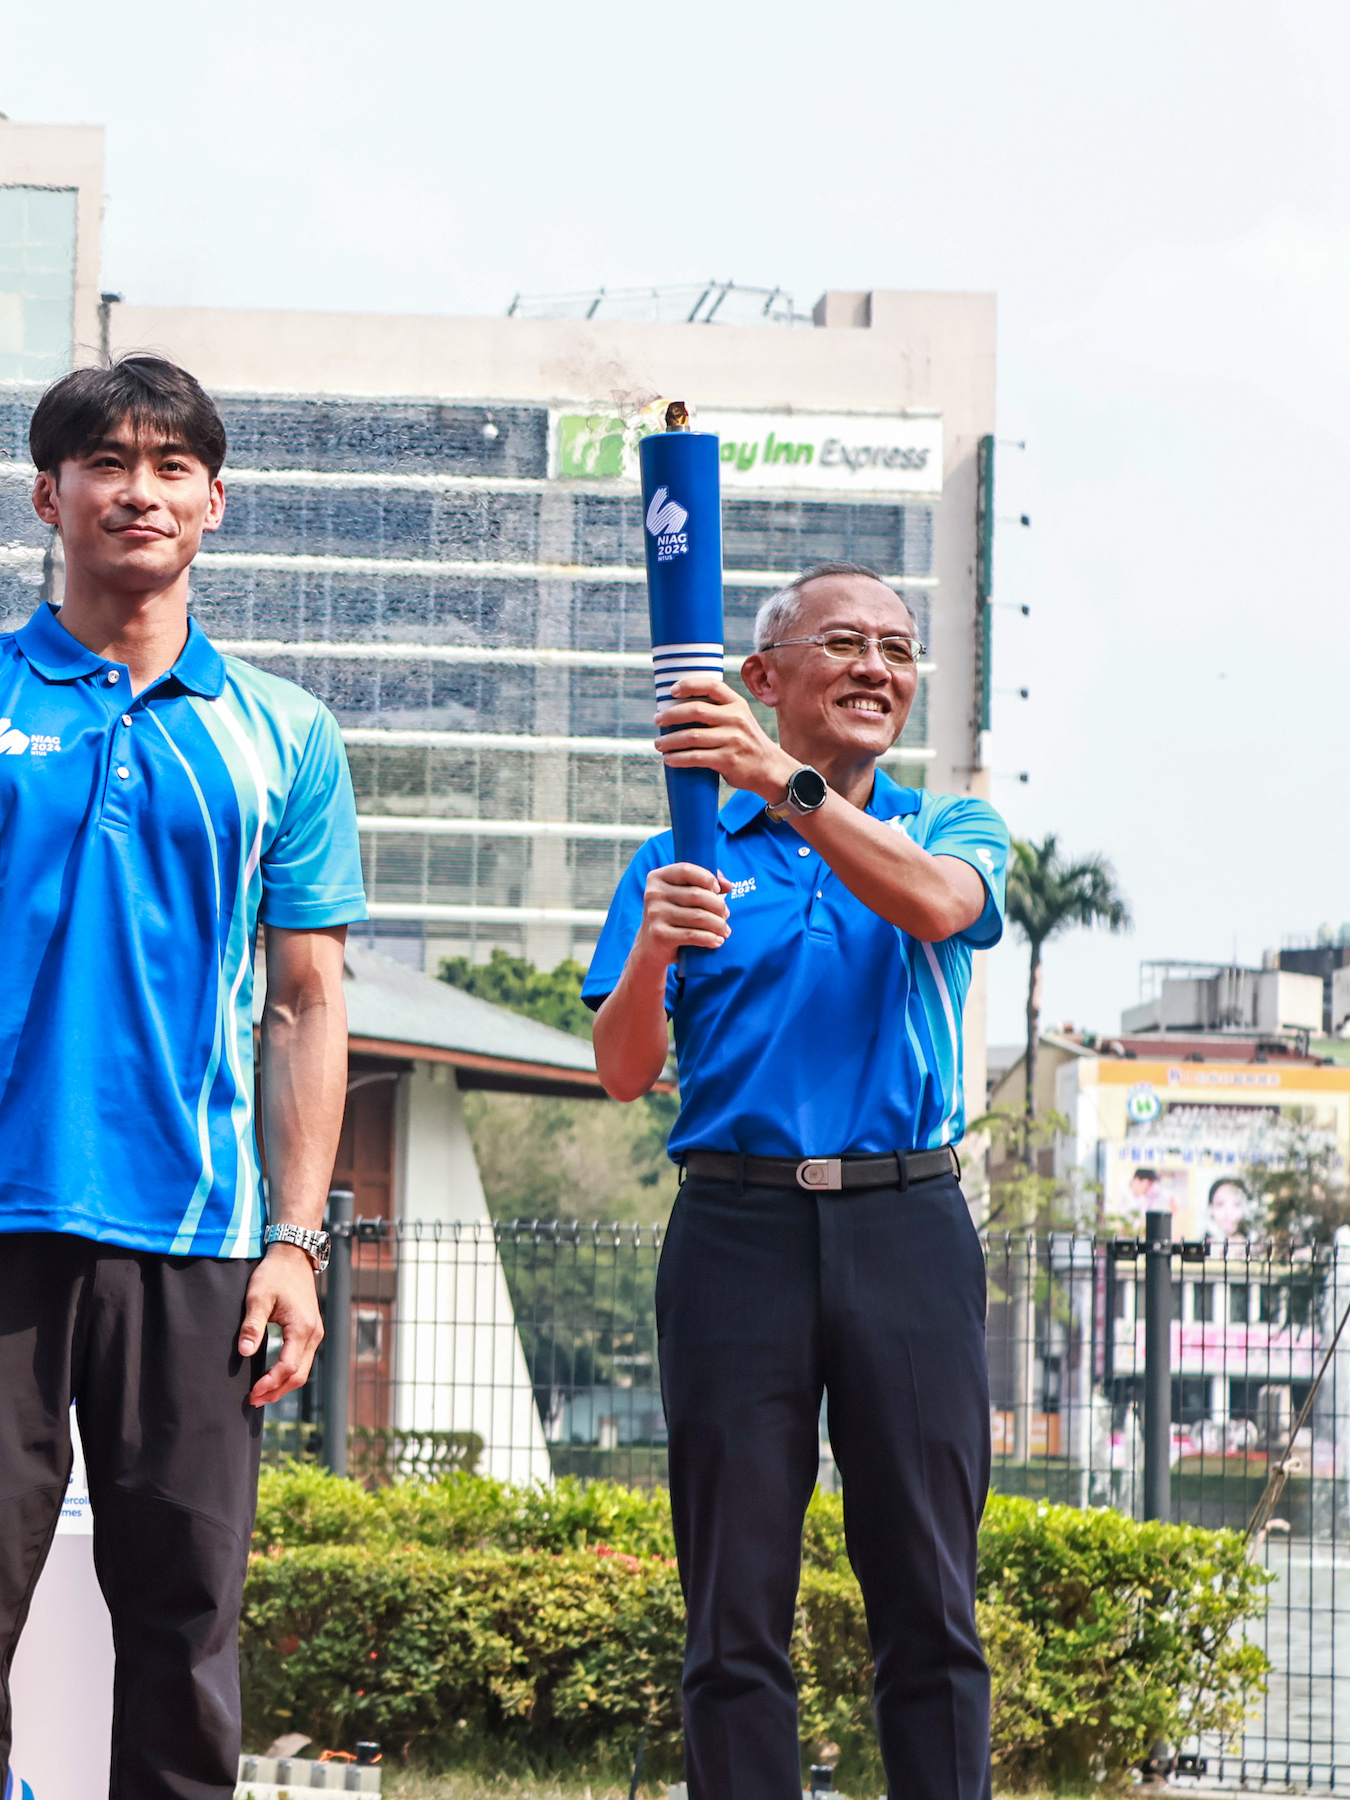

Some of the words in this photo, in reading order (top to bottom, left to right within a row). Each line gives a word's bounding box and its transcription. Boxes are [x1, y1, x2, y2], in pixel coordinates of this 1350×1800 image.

[764, 431, 814, 464] Inn
[819, 438, 931, 472] Express
[657, 533, 687, 546] NIAG
[658, 544, 687, 555] 2024
[30, 734, 61, 744] NIAG
[31, 742, 62, 752] 2024
[731, 877, 756, 889] NIAG
[731, 885, 757, 896] 2024
